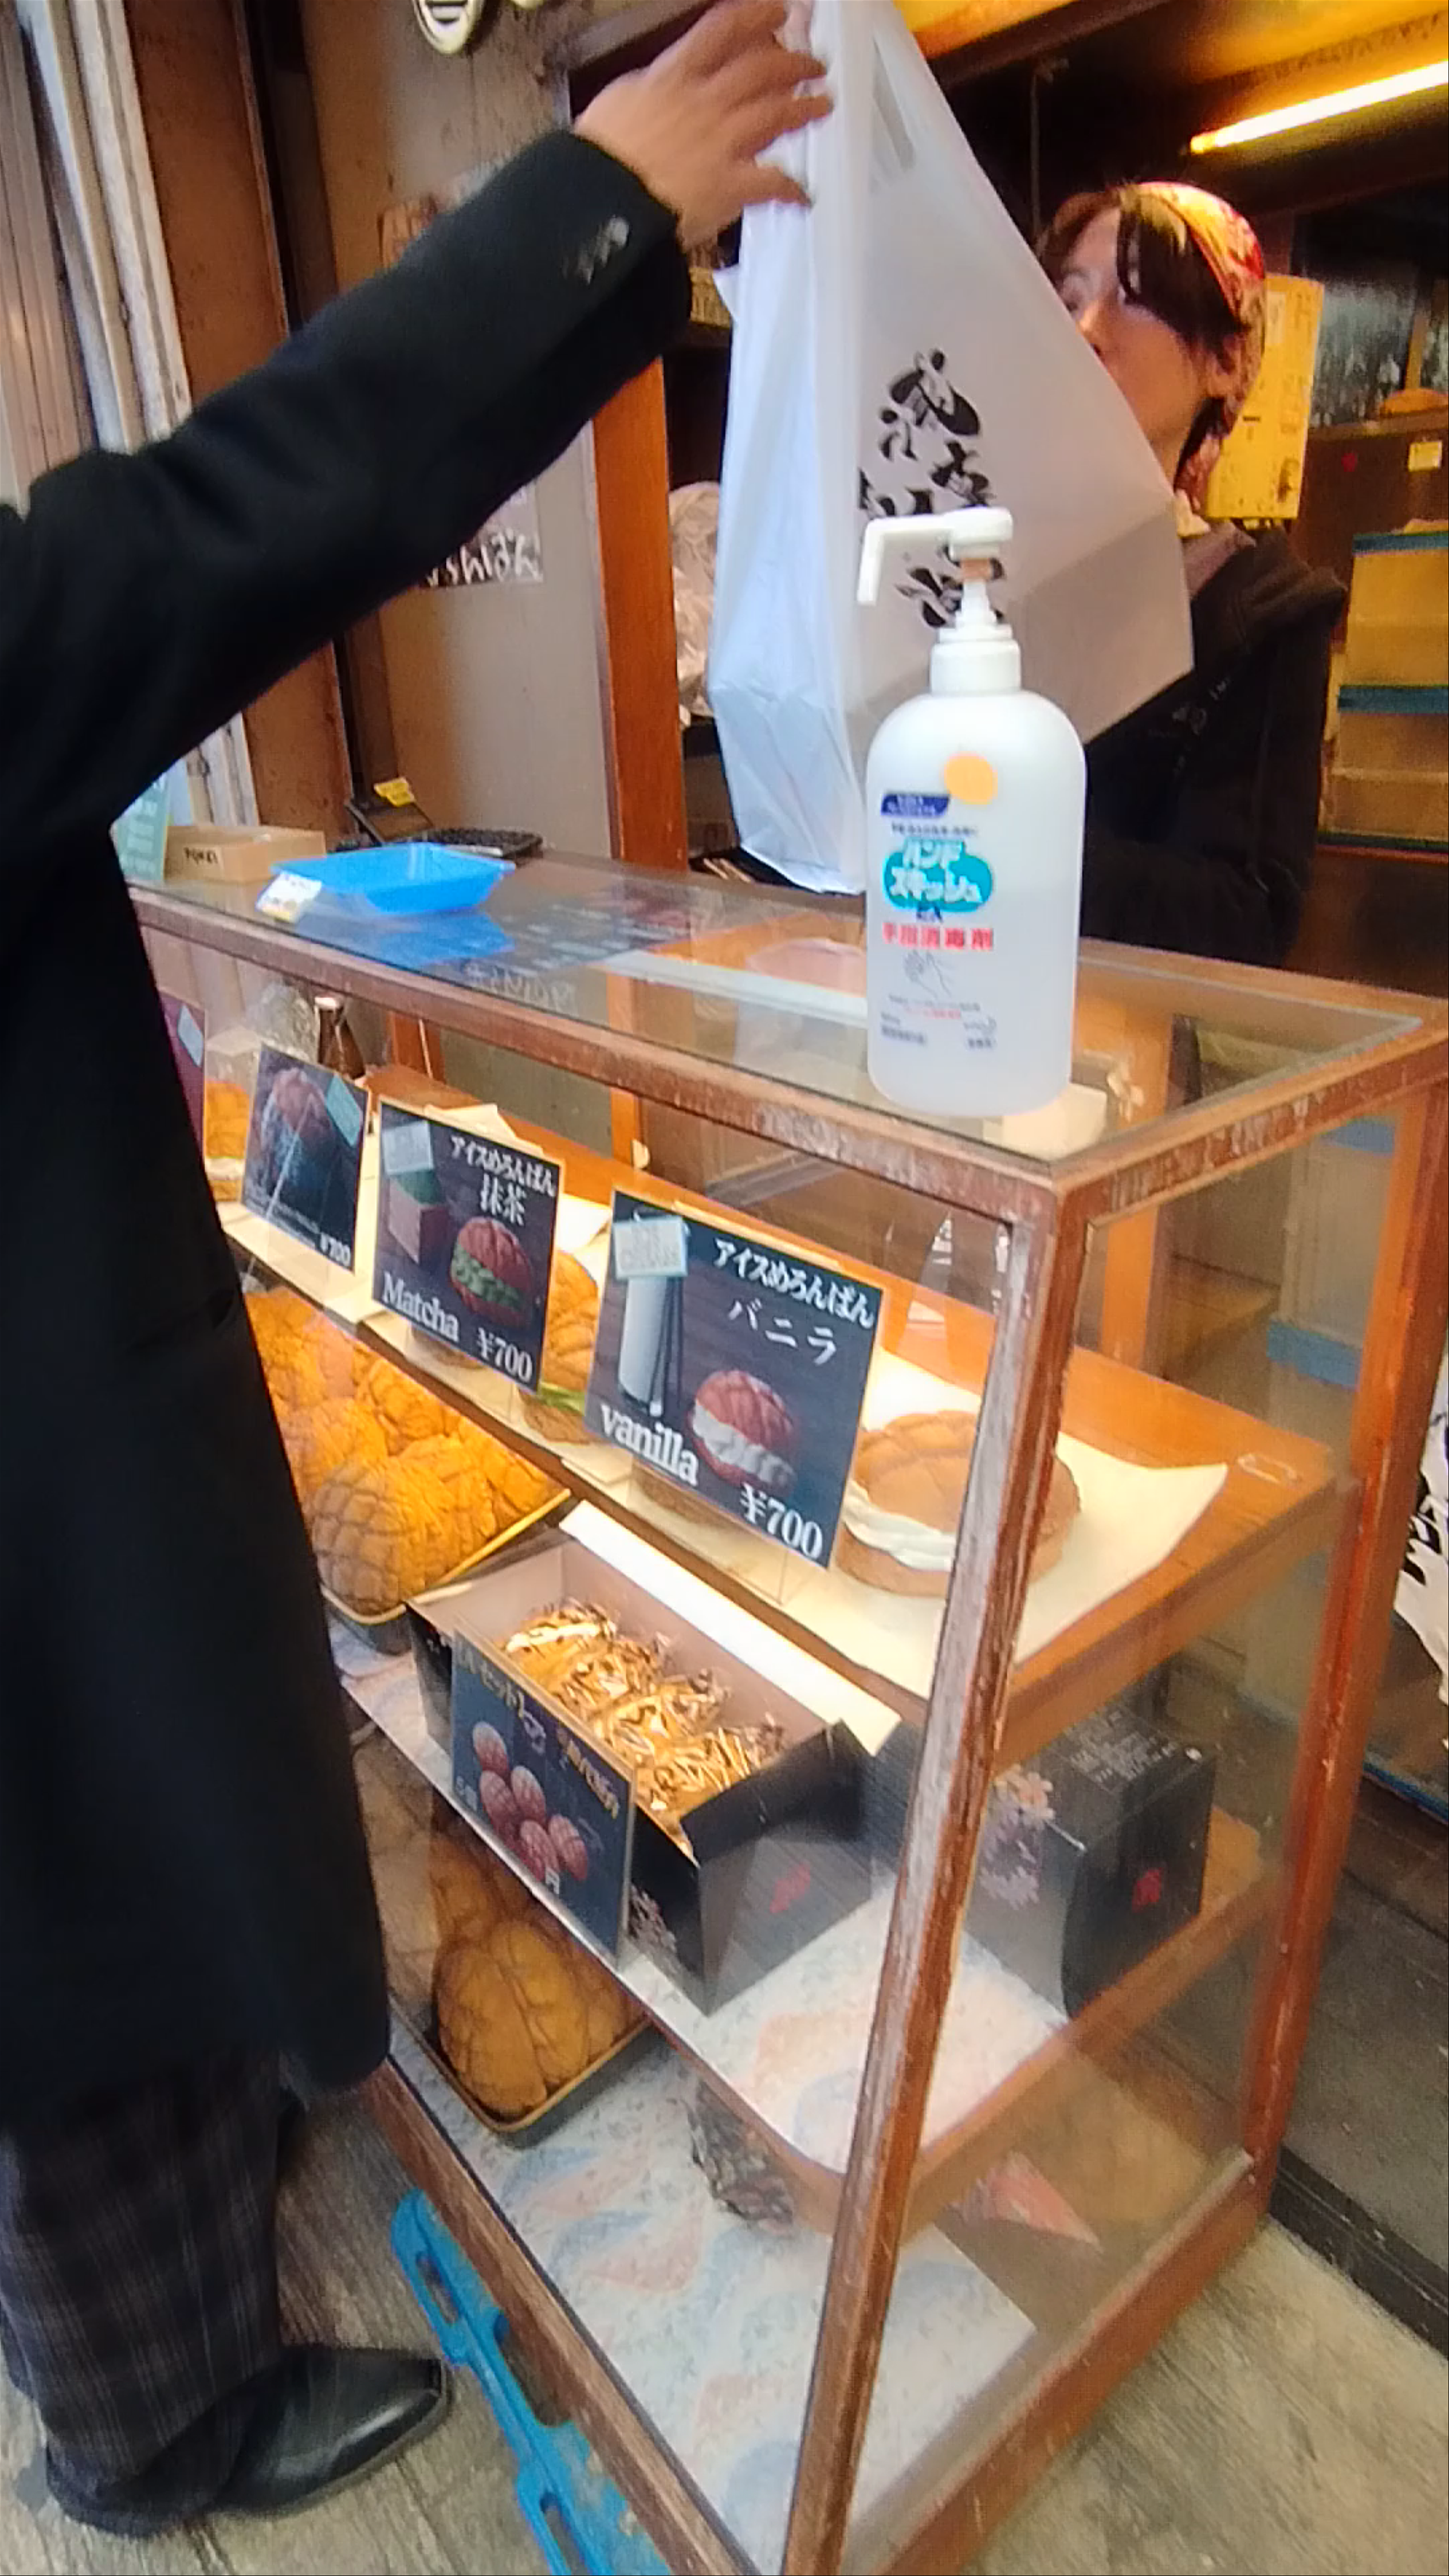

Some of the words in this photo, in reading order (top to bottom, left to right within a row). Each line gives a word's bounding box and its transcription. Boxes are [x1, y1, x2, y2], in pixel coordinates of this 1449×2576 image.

[479, 1172, 527, 1227] 抹茶
[382, 1271, 460, 1343] Matcha
[728, 1298, 837, 1367] バニラ
[476, 1326, 533, 1383] ¥700
[601, 1404, 699, 1487] vanilla
[740, 1481, 823, 1560] ¥700
